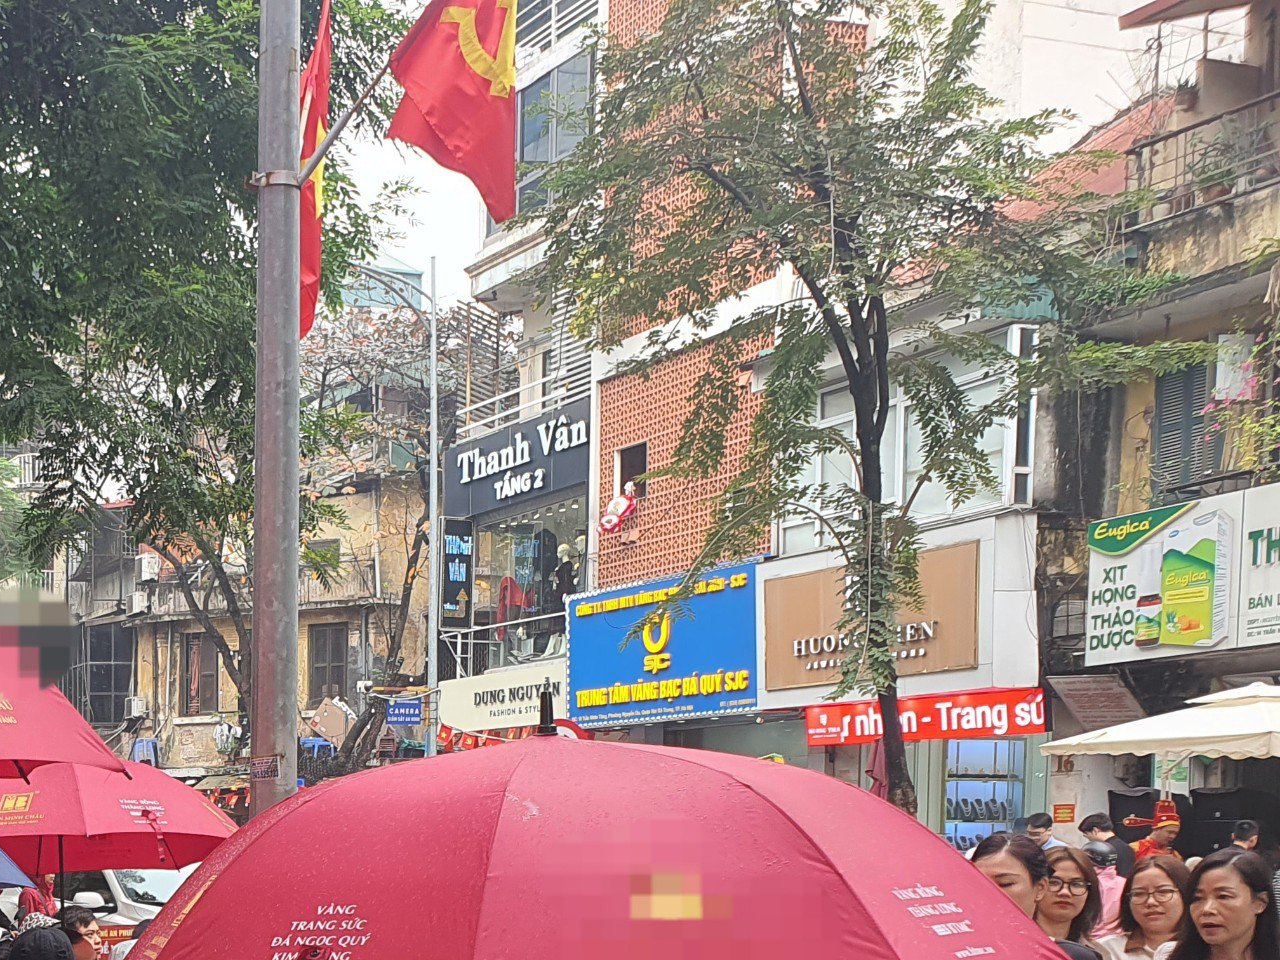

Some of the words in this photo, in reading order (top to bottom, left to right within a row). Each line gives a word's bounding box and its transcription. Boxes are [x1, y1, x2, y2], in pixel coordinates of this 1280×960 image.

[457, 433, 530, 484] Thanh
[537, 415, 587, 455] Vân
[494, 474, 533, 500] TẦNG
[533, 468, 545, 489] 2
[1094, 519, 1150, 540] Eugica
[730, 573, 748, 588] SJC
[1102, 565, 1127, 585] XỊT
[1091, 584, 1136, 609] HỌNG
[1248, 593, 1273, 610] BÁN
[1091, 607, 1134, 630] THẢO
[1089, 629, 1134, 650] DƯỢC
[643, 653, 671, 674] SJC
[576, 688, 607, 708] TRUNG
[608, 682, 630, 705] TÂM
[630, 679, 660, 701] VÀNG
[660, 680, 682, 702] BẠC
[682, 671, 699, 698] ĐÁ
[700, 668, 724, 695] QUÝ
[724, 669, 750, 691] SJC
[489, 706, 517, 718] FASHION
[524, 704, 541, 714] STYL
[935, 701, 1008, 735] Trang
[1057, 754, 1075, 773] 16
[317, 902, 357, 915] VÀNG
[291, 921, 337, 931] TRANG
[339, 917, 368, 931] SỨC
[271, 934, 291, 947] ĐÁ
[337, 932, 372, 946] QUÝ
